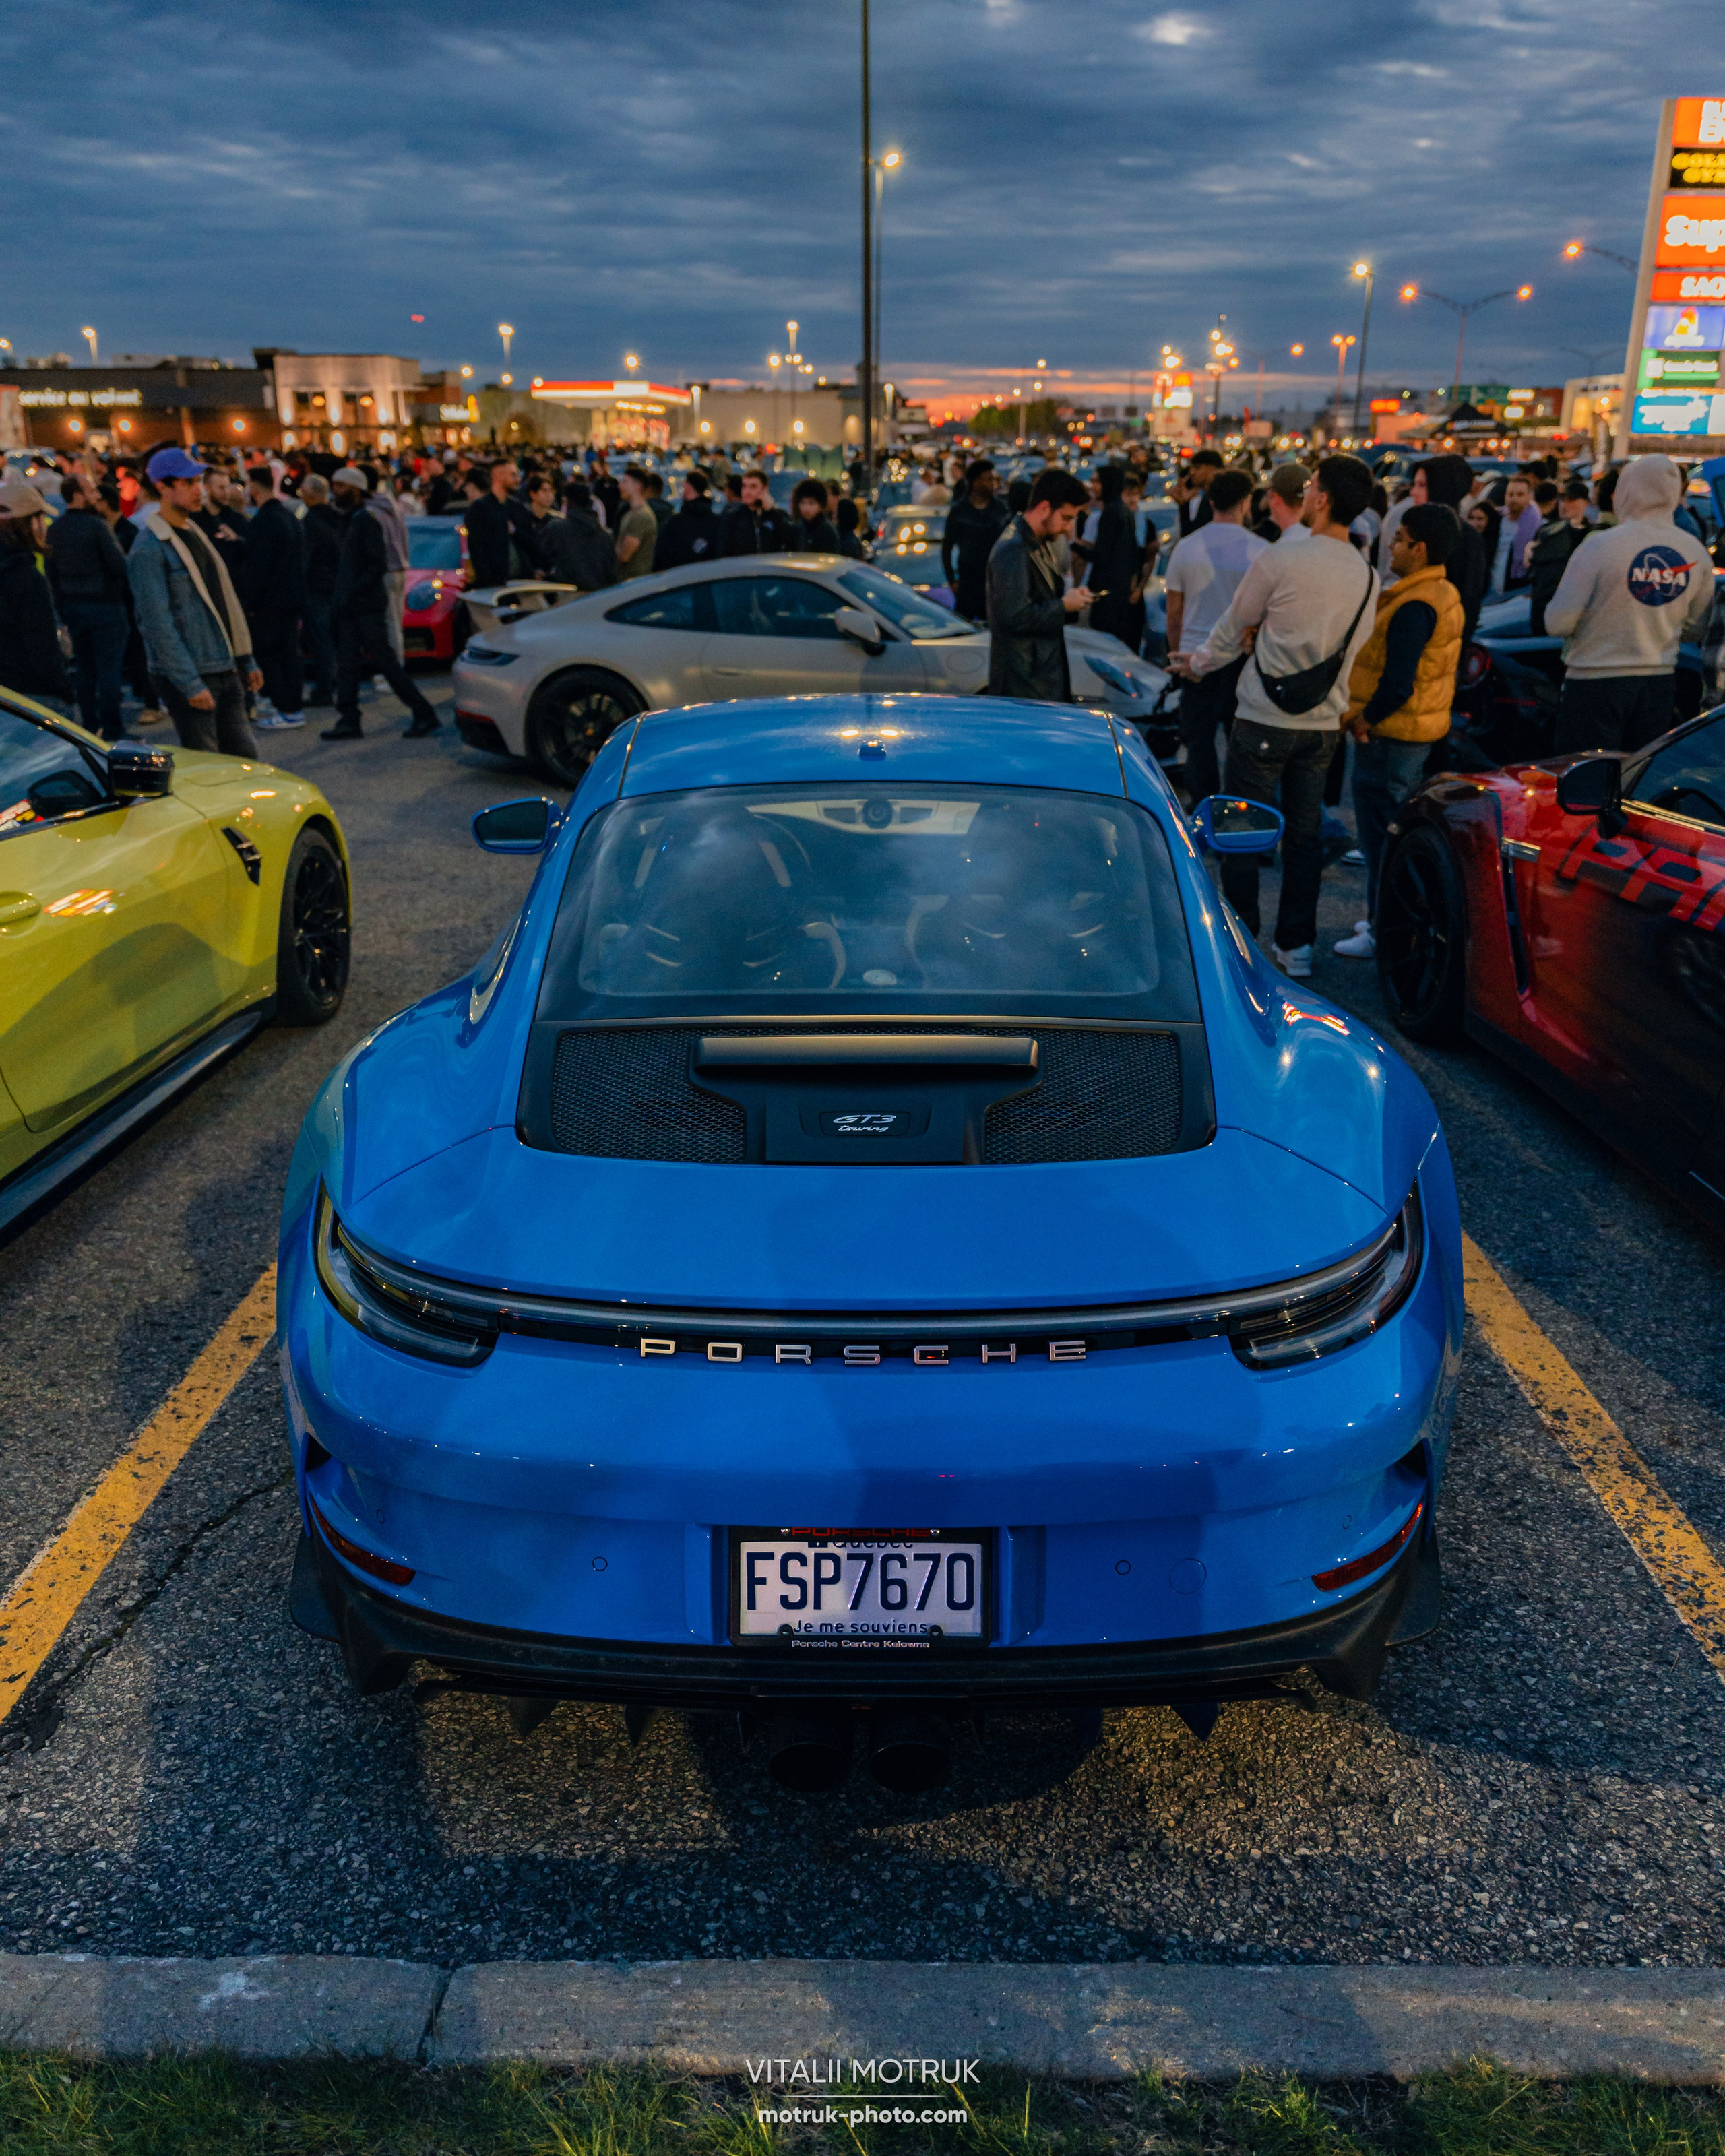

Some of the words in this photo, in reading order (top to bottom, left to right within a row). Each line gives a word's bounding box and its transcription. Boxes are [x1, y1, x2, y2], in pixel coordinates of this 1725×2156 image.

[1632, 567, 1686, 587] NASA
[833, 1114, 896, 1124] GT3
[838, 1124, 889, 1133] touring
[640, 1337, 1088, 1364] PORSCHE
[746, 1552, 974, 1610] FSP7670
[793, 1620, 813, 1633] Je
[819, 1622, 844, 1633] me
[850, 1620, 928, 1633] souviens
[792, 1640, 838, 1648] Porsche
[841, 1640, 880, 1648] Centre
[883, 1640, 930, 1648] Kelowna
